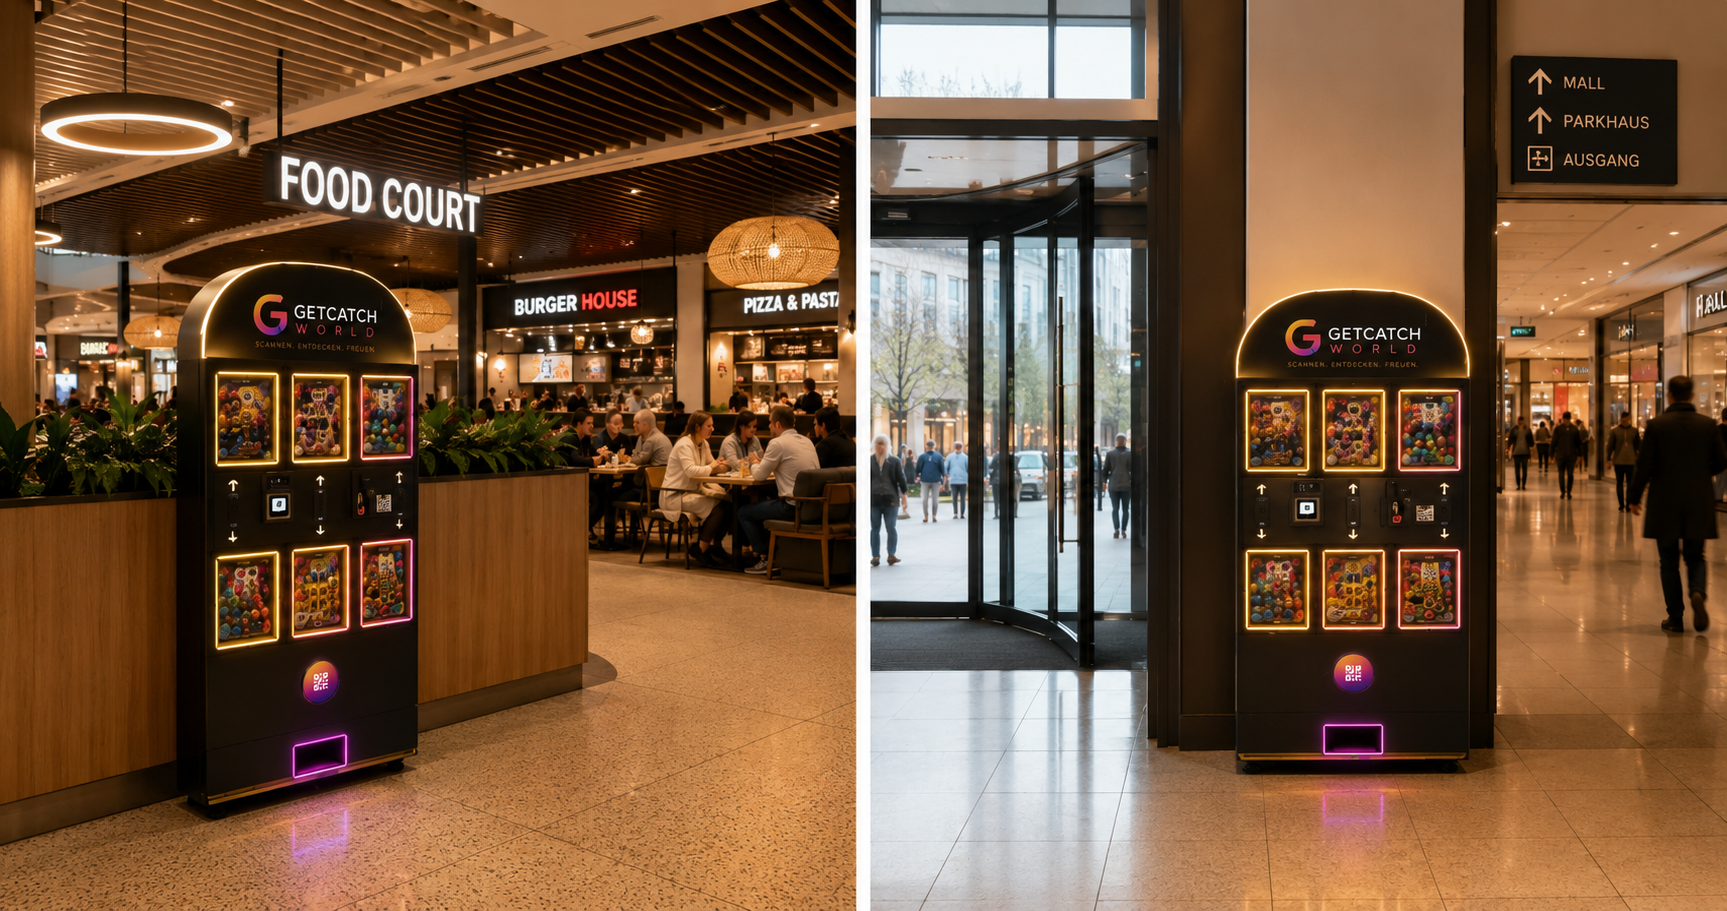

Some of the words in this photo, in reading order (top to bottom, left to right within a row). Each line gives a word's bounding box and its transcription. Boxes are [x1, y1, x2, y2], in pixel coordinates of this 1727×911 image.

[1563, 76, 1606, 90] MALL
[1563, 114, 1650, 129] PARKHAUS
[1563, 153, 1640, 168] AUSGANG
[280, 155, 373, 214] FOOD
[382, 177, 481, 233] COURT
[514, 294, 578, 316] BURGER
[581, 289, 638, 311] HOUSE
[743, 295, 784, 314] PIZZA
[786, 294, 798, 311] &
[294, 304, 377, 324] GETCATCH
[295, 323, 375, 338] WORLD
[1328, 327, 1421, 341] GETCATCH
[1330, 344, 1417, 354] WORLD
